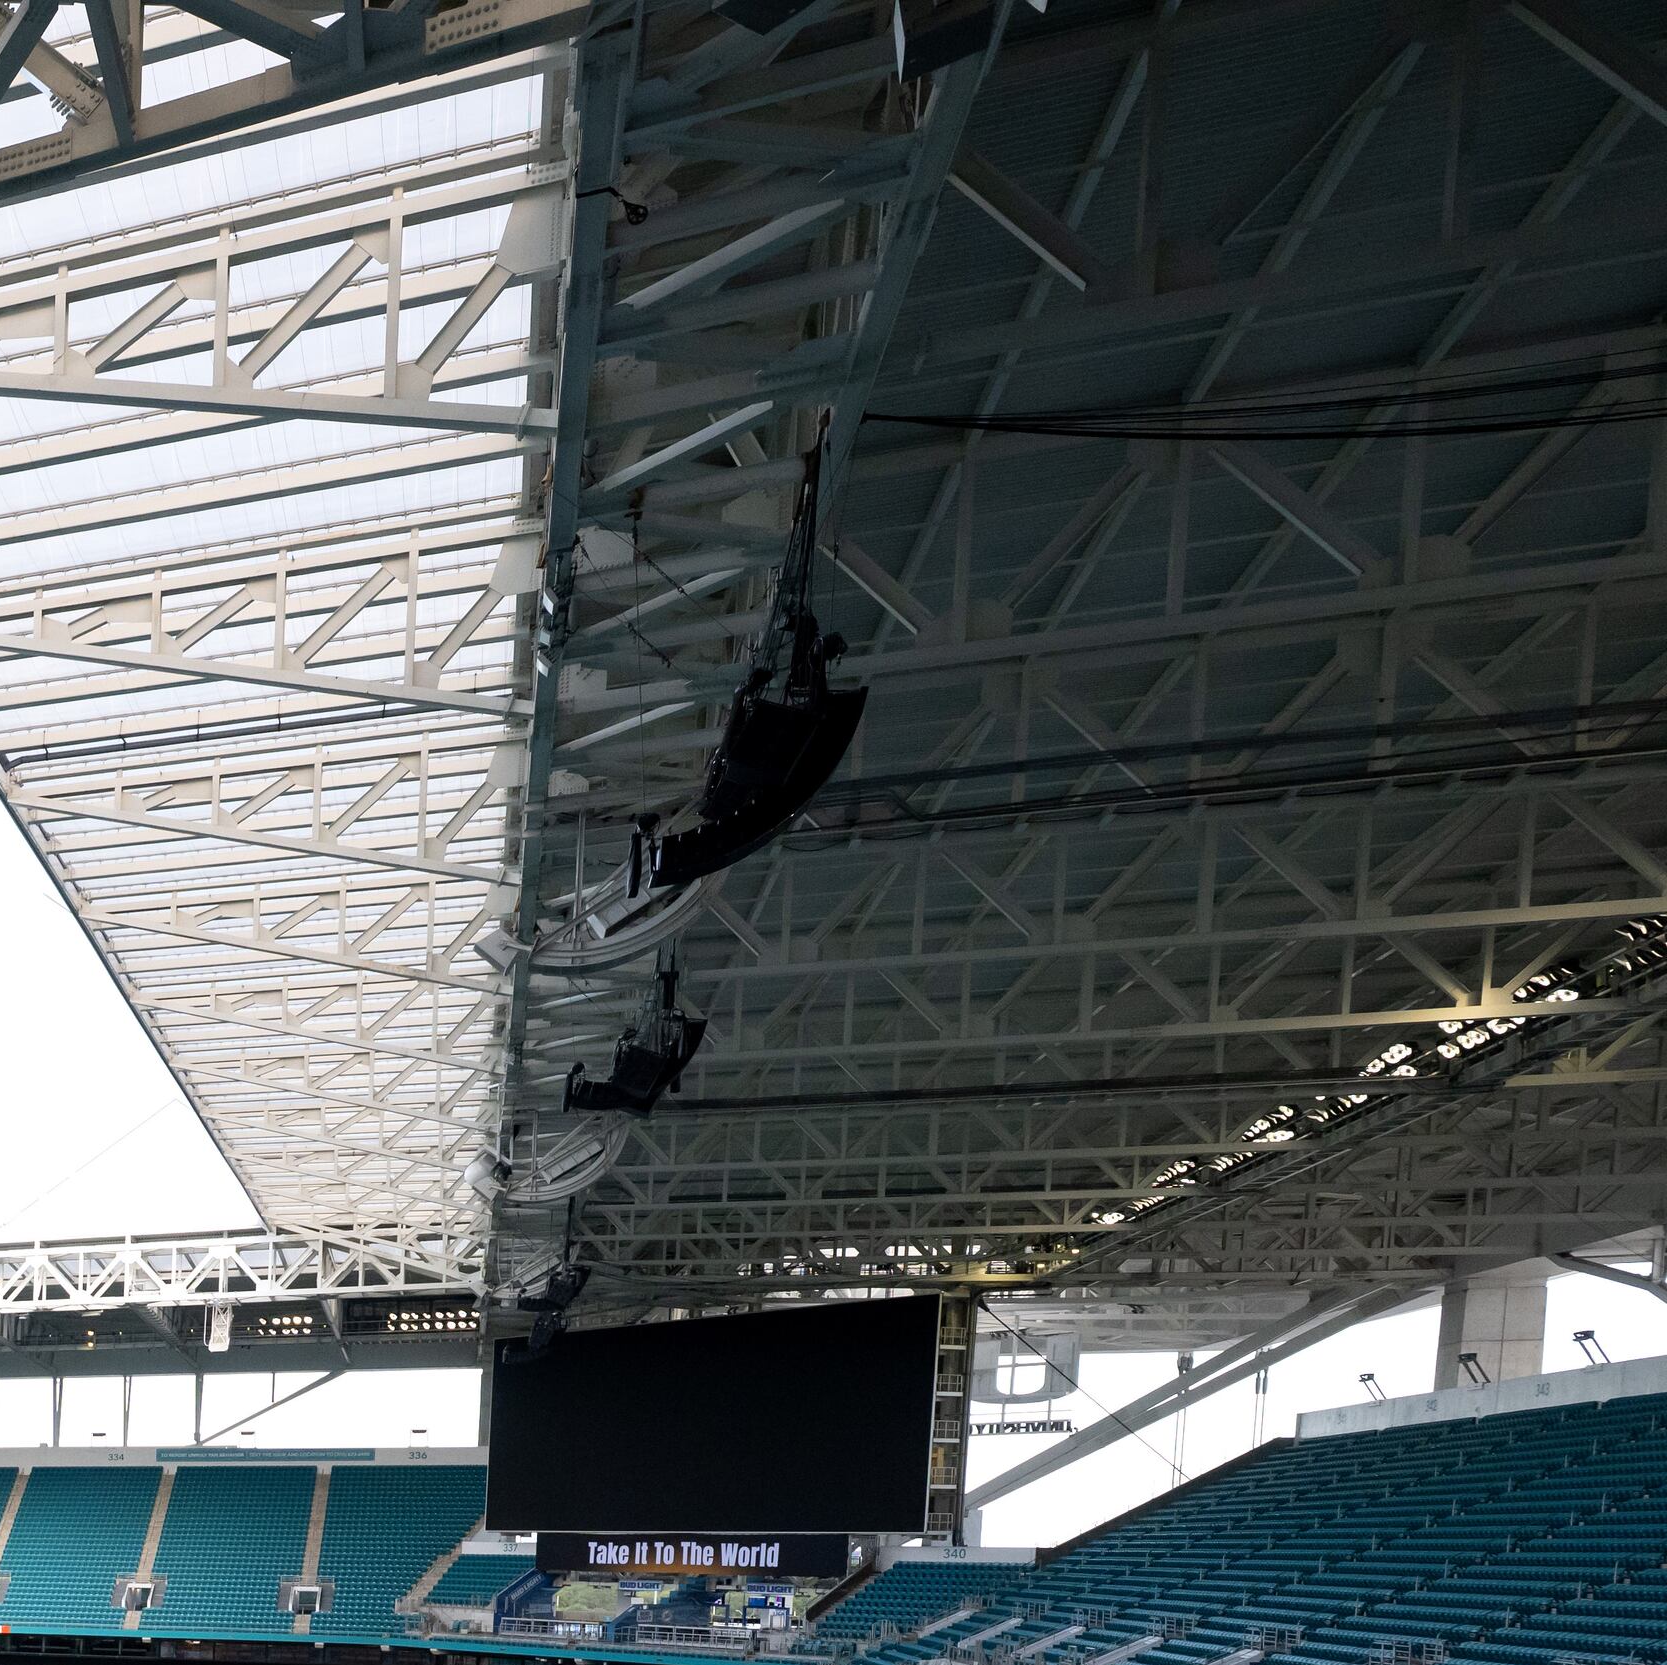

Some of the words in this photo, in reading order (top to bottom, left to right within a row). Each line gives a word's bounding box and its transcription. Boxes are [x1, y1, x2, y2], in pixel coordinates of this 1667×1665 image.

[408, 1451, 427, 1459] 336
[503, 1544, 518, 1552] 337
[588, 1542, 629, 1565] Take
[634, 1542, 649, 1565] It
[654, 1542, 675, 1565] To
[681, 1543, 714, 1566] The
[720, 1543, 780, 1568] World
[943, 1548, 966, 1559] 340
[510, 1588, 525, 1601] BUD
[523, 1575, 542, 1591] LIGHT
[637, 1582, 660, 1590] LIGHT
[748, 1584, 766, 1592] BUD
[767, 1585, 793, 1593] LIGHT
